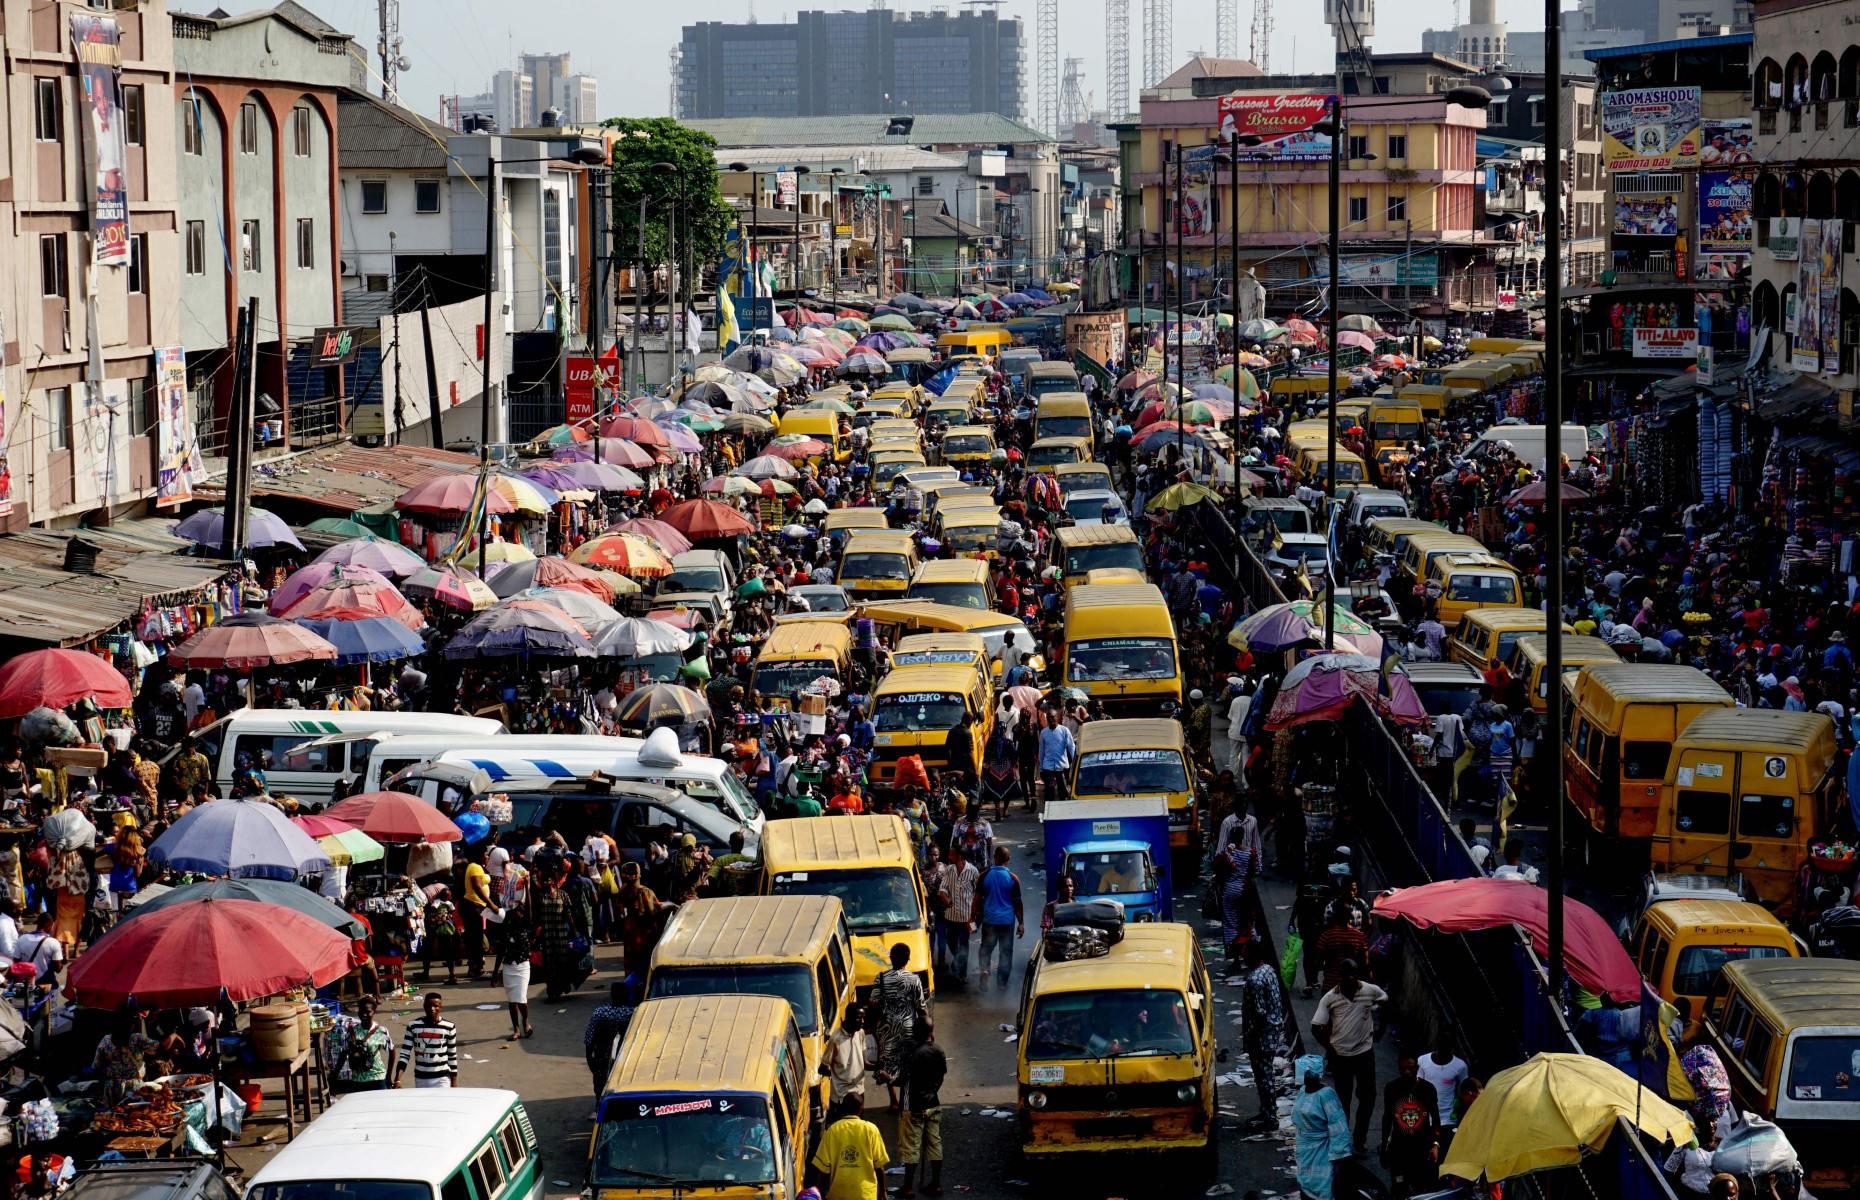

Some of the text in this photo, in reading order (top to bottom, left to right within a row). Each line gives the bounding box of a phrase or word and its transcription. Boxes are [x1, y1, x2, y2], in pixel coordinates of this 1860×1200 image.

[1221, 96, 1325, 112] Seasons Greeting
[1609, 89, 1694, 105] AROMASHODU
[1246, 111, 1307, 126] Brasas
[742, 306, 769, 316] Ecoank
[1637, 329, 1695, 341] TITI-ALAYO
[569, 403, 591, 414] ATM
[155, 721, 172, 736] 23
